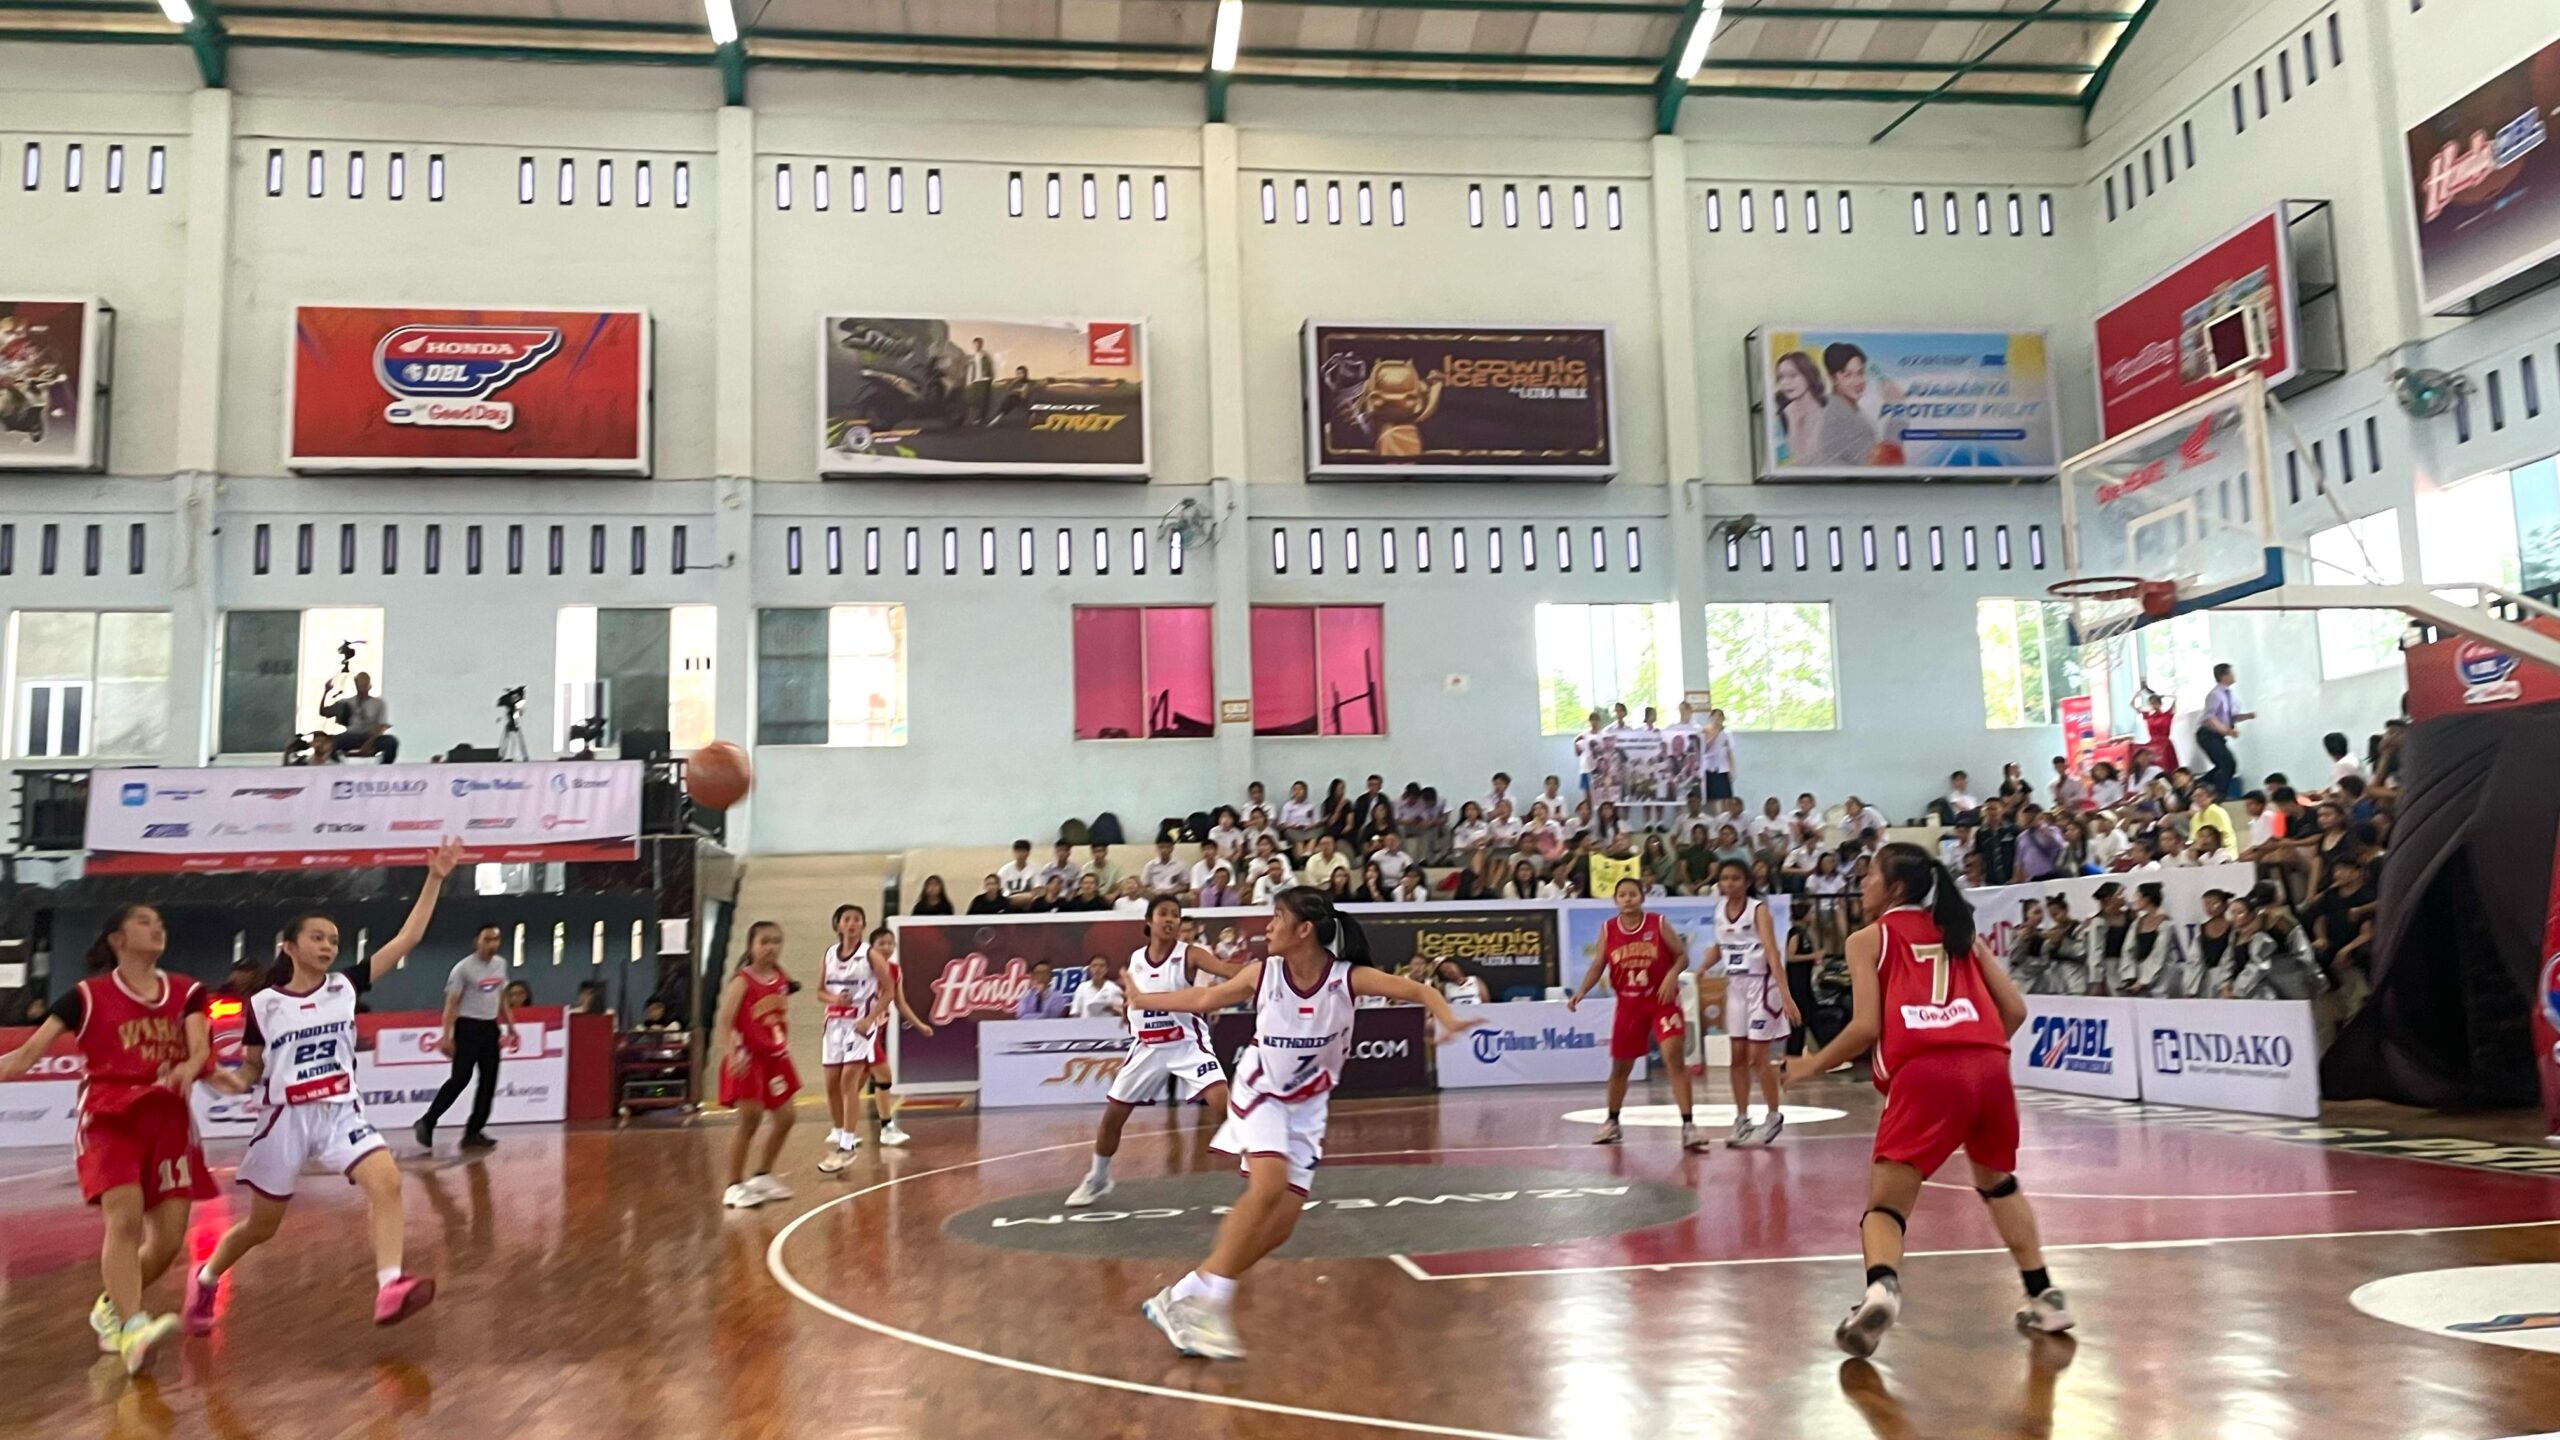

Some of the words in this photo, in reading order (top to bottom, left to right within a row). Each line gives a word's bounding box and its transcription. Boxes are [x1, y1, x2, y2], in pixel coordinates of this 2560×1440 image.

[426, 342, 515, 355] HONDA
[423, 364, 470, 382] DBL
[1445, 372, 1488, 387] ICE
[1492, 373, 1588, 388] CREAM
[1457, 944, 1540, 958] CREAM
[1628, 969, 1649, 986] 14
[1911, 943, 1950, 1005] 7
[934, 957, 1033, 1019] Honda
[1660, 1012, 1682, 1033] 14
[294, 1040, 337, 1066] 23
[2029, 1016, 2065, 1069] 20
[2066, 1018, 2113, 1058] DBL
[2184, 1032, 2292, 1068] INDAKO
[1293, 1054, 1318, 1075] 7
[158, 1155, 192, 1192] 11
